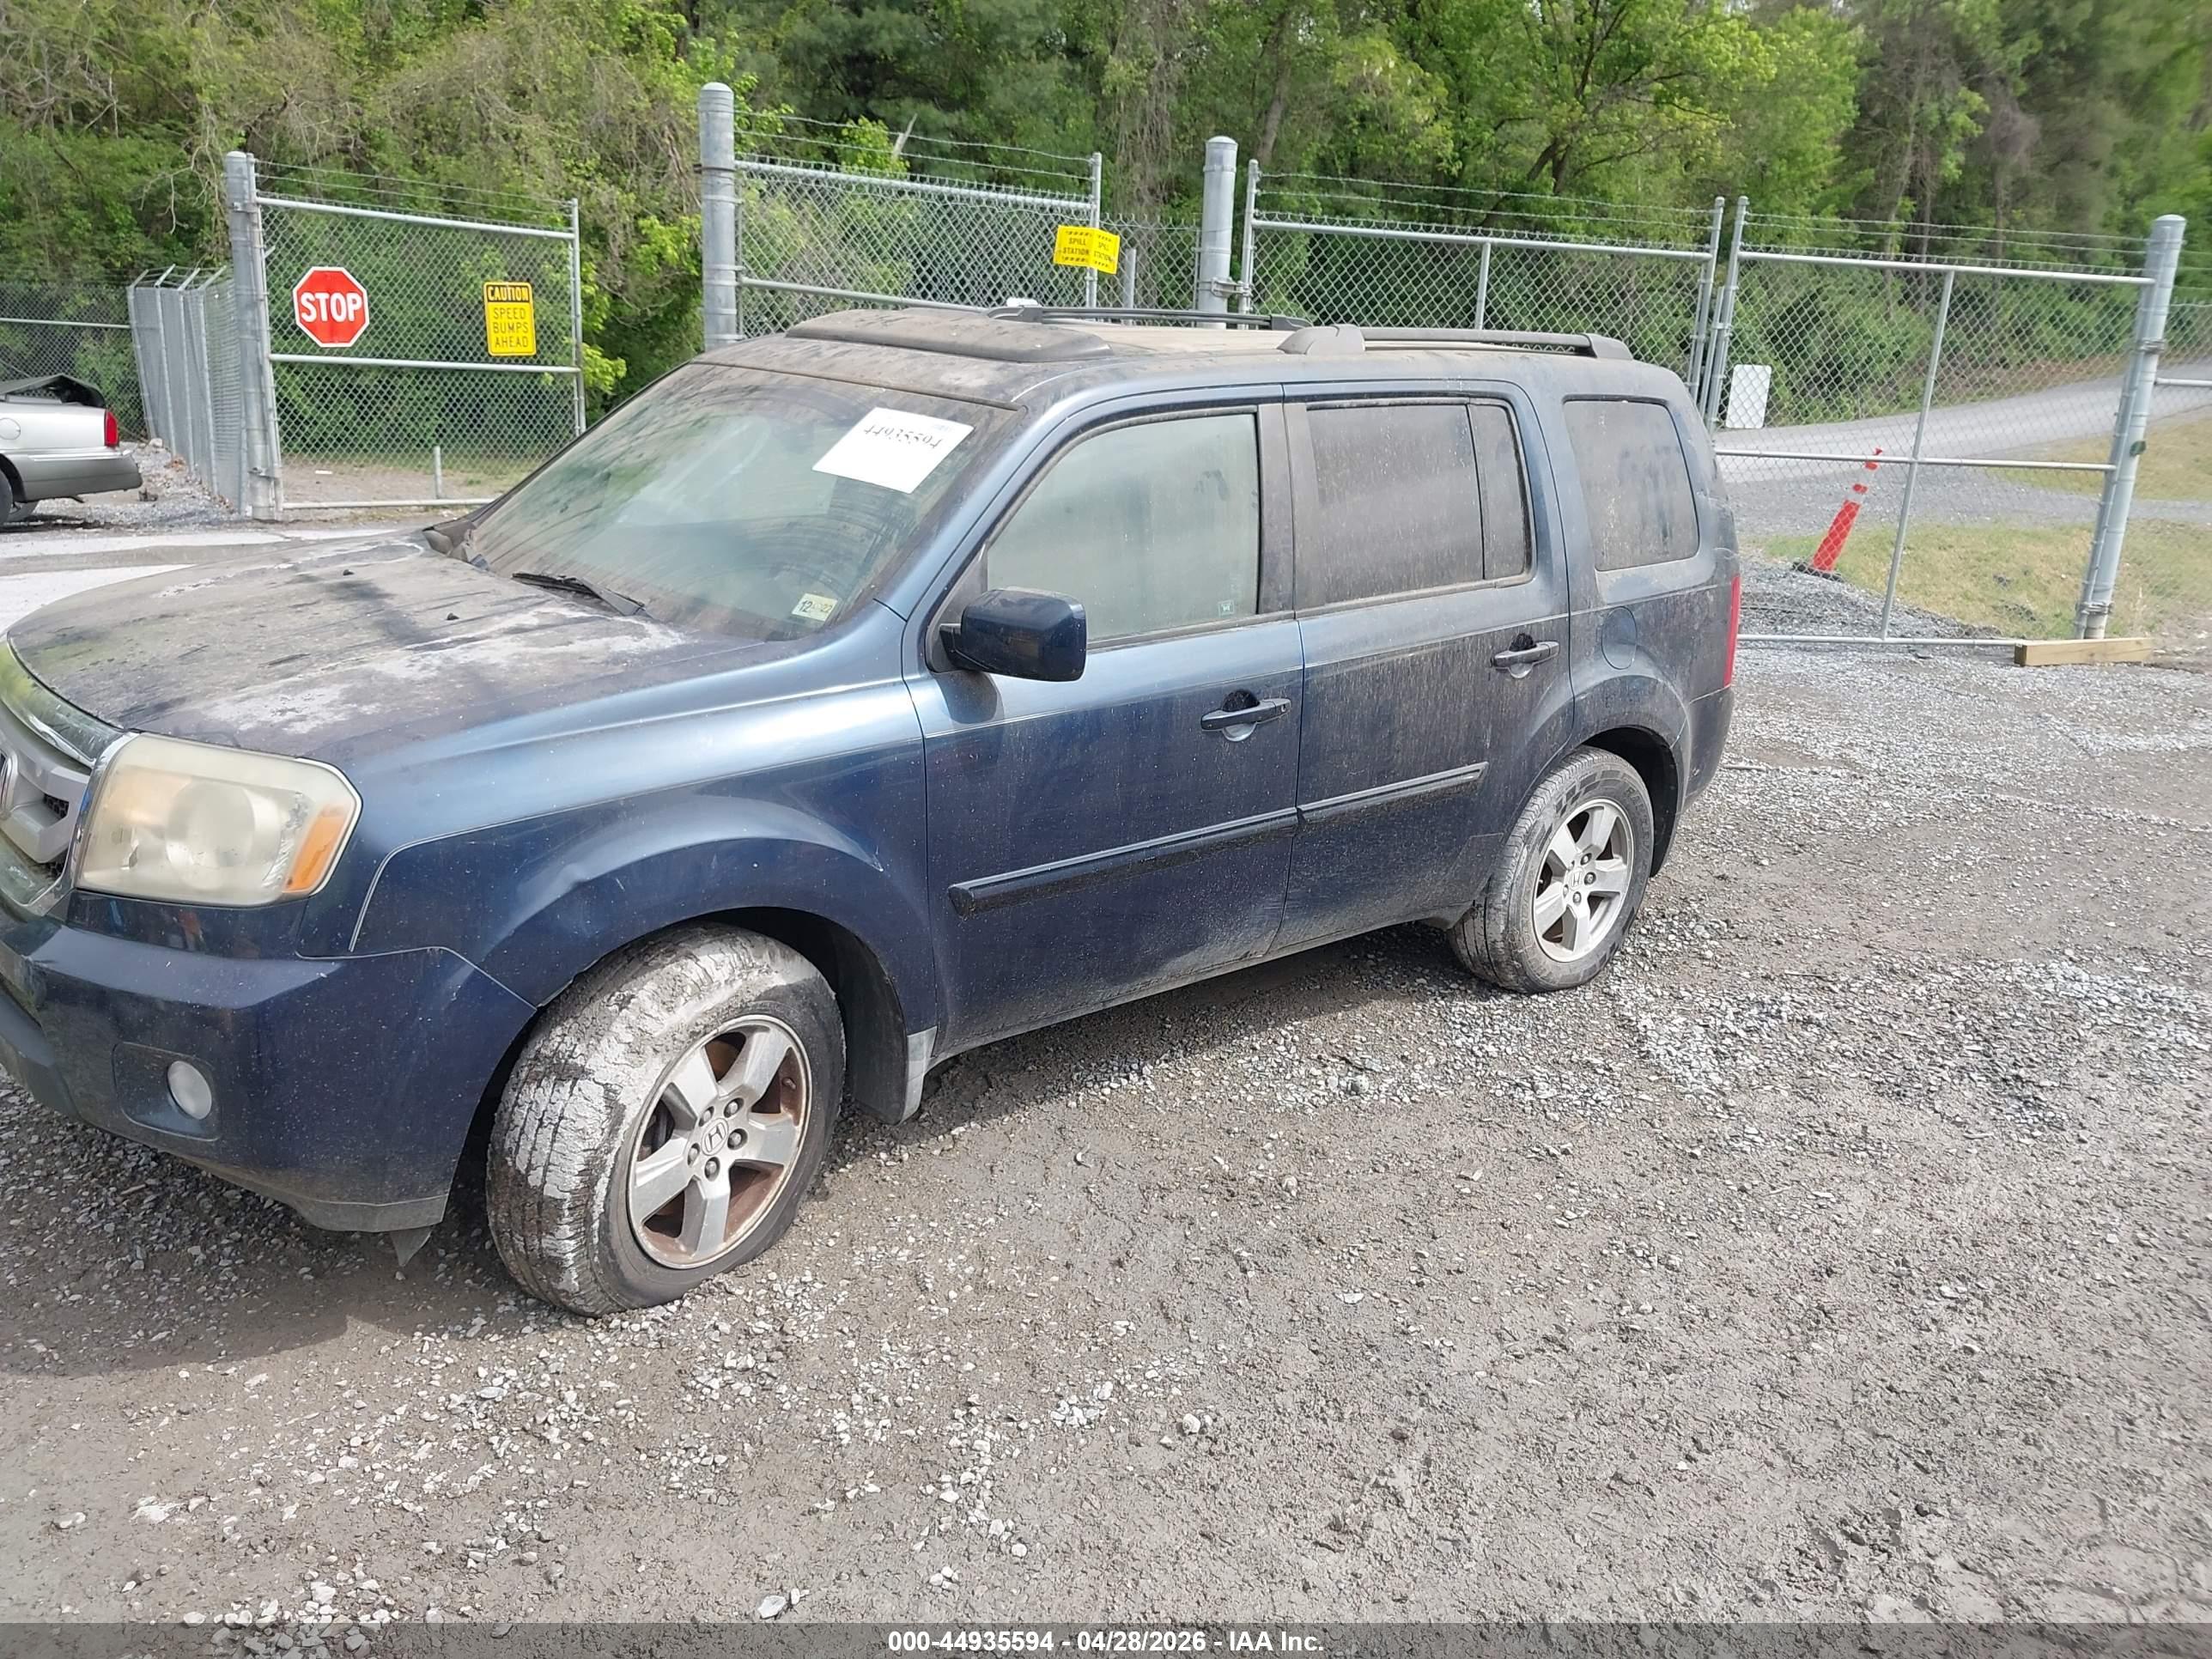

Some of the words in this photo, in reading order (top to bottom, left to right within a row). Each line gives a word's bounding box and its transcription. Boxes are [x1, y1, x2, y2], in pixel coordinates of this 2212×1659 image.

[1068, 237, 1087, 246] SPILL
[1062, 246, 1090, 256] STATION
[487, 285, 529, 301] CAUTION
[301, 292, 362, 322] STOP
[493, 307, 526, 320] SPEED
[493, 322, 529, 334] BUMPS
[494, 336, 529, 349] AHEAD
